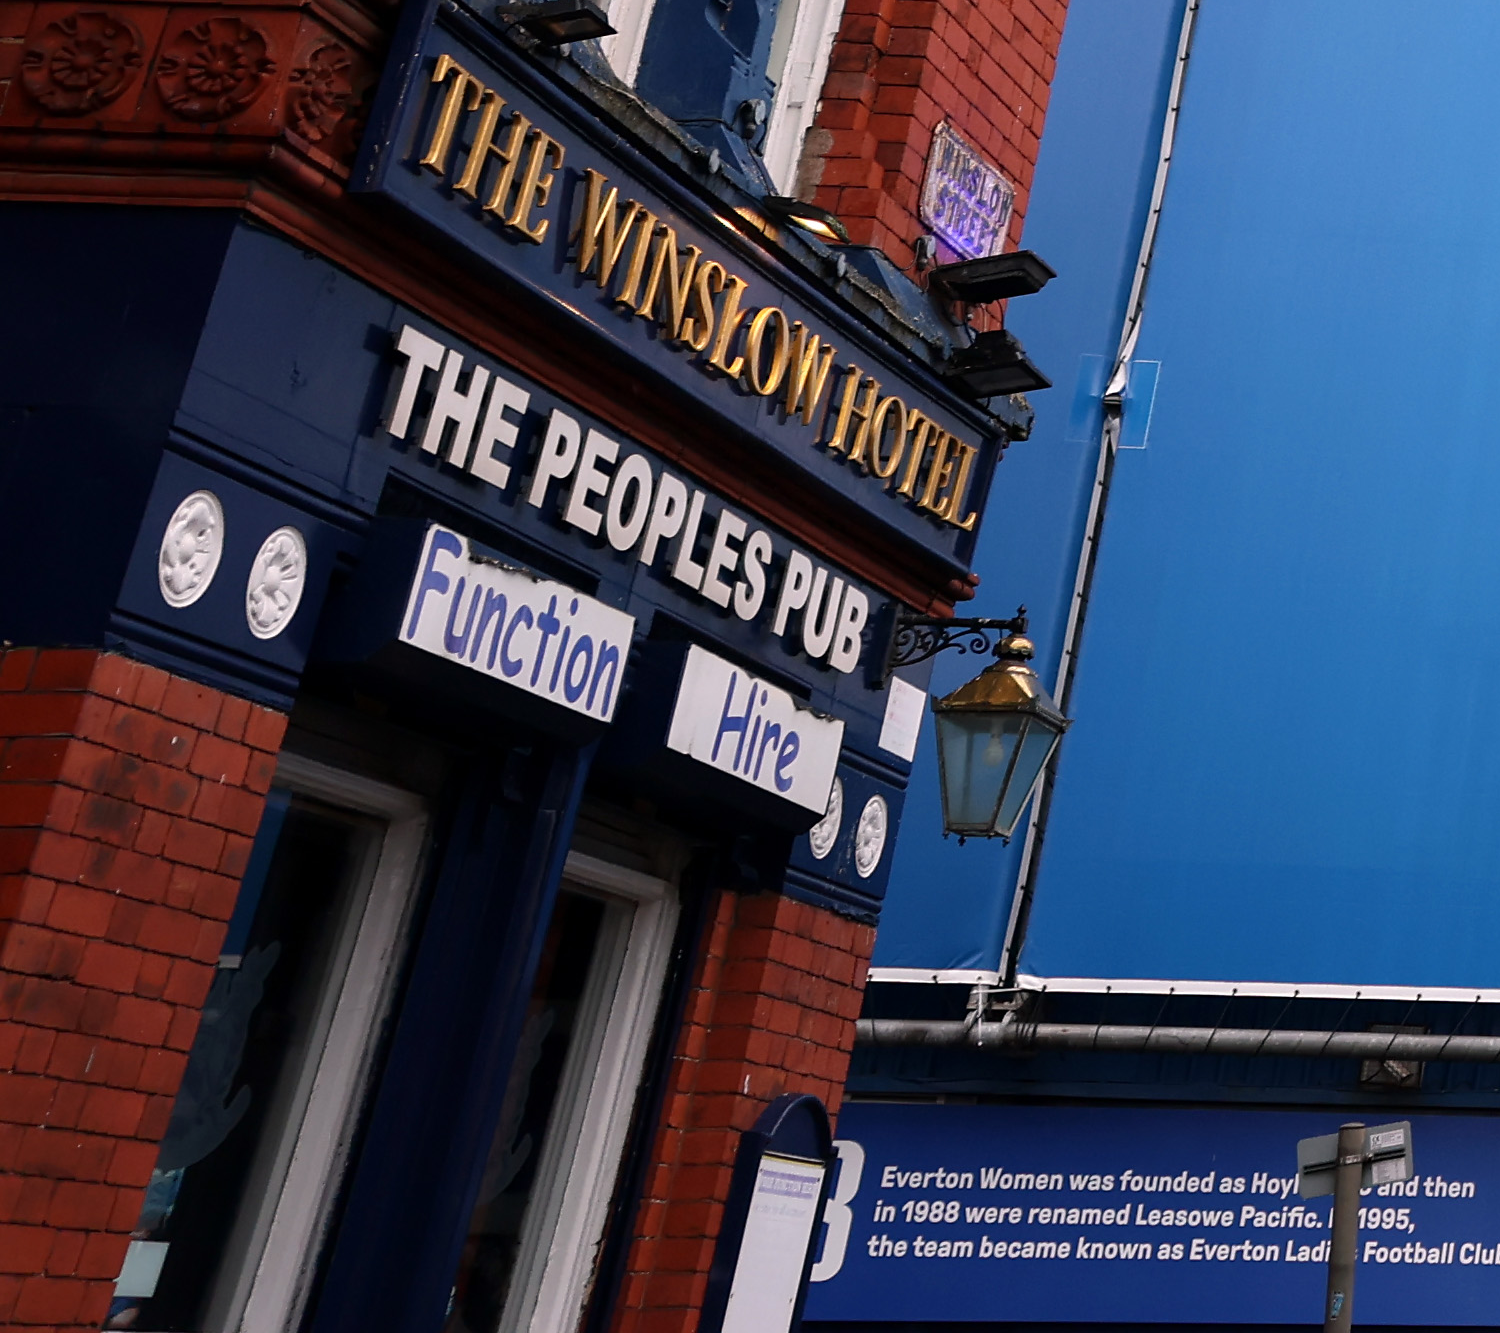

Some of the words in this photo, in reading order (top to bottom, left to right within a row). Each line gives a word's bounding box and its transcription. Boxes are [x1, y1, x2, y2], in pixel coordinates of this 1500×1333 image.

[420, 53, 567, 244] THE
[576, 167, 838, 426] WINSLOW
[828, 363, 979, 531] HOTEL
[386, 324, 531, 490] THE
[528, 408, 772, 621] PEOPLES
[771, 549, 869, 673] PUB
[406, 528, 619, 718] Function
[711, 670, 799, 793] Hire
[873, 1200, 896, 1222] in
[902, 1201, 960, 1223] 1988
[965, 1206, 1022, 1224] were
[1027, 1203, 1131, 1225] renamed
[1135, 1204, 1233, 1227] Leasowe
[1239, 1206, 1323, 1229] Pacific.
[1358, 1208, 1416, 1234] 1995,
[881, 1166, 973, 1189] Everton
[980, 1167, 1063, 1190] Women
[1069, 1173, 1115, 1191] was
[1119, 1170, 1215, 1194] founded
[1219, 1177, 1246, 1193] as
[1377, 1176, 1418, 1197] and
[1424, 1176, 1475, 1198] then
[867, 1234, 907, 1257] the
[913, 1235, 973, 1258] team
[979, 1236, 1070, 1259] became
[1076, 1237, 1152, 1260] known
[1157, 1243, 1184, 1261] as
[1189, 1239, 1279, 1262] Everton
[1363, 1241, 1454, 1264] Football
